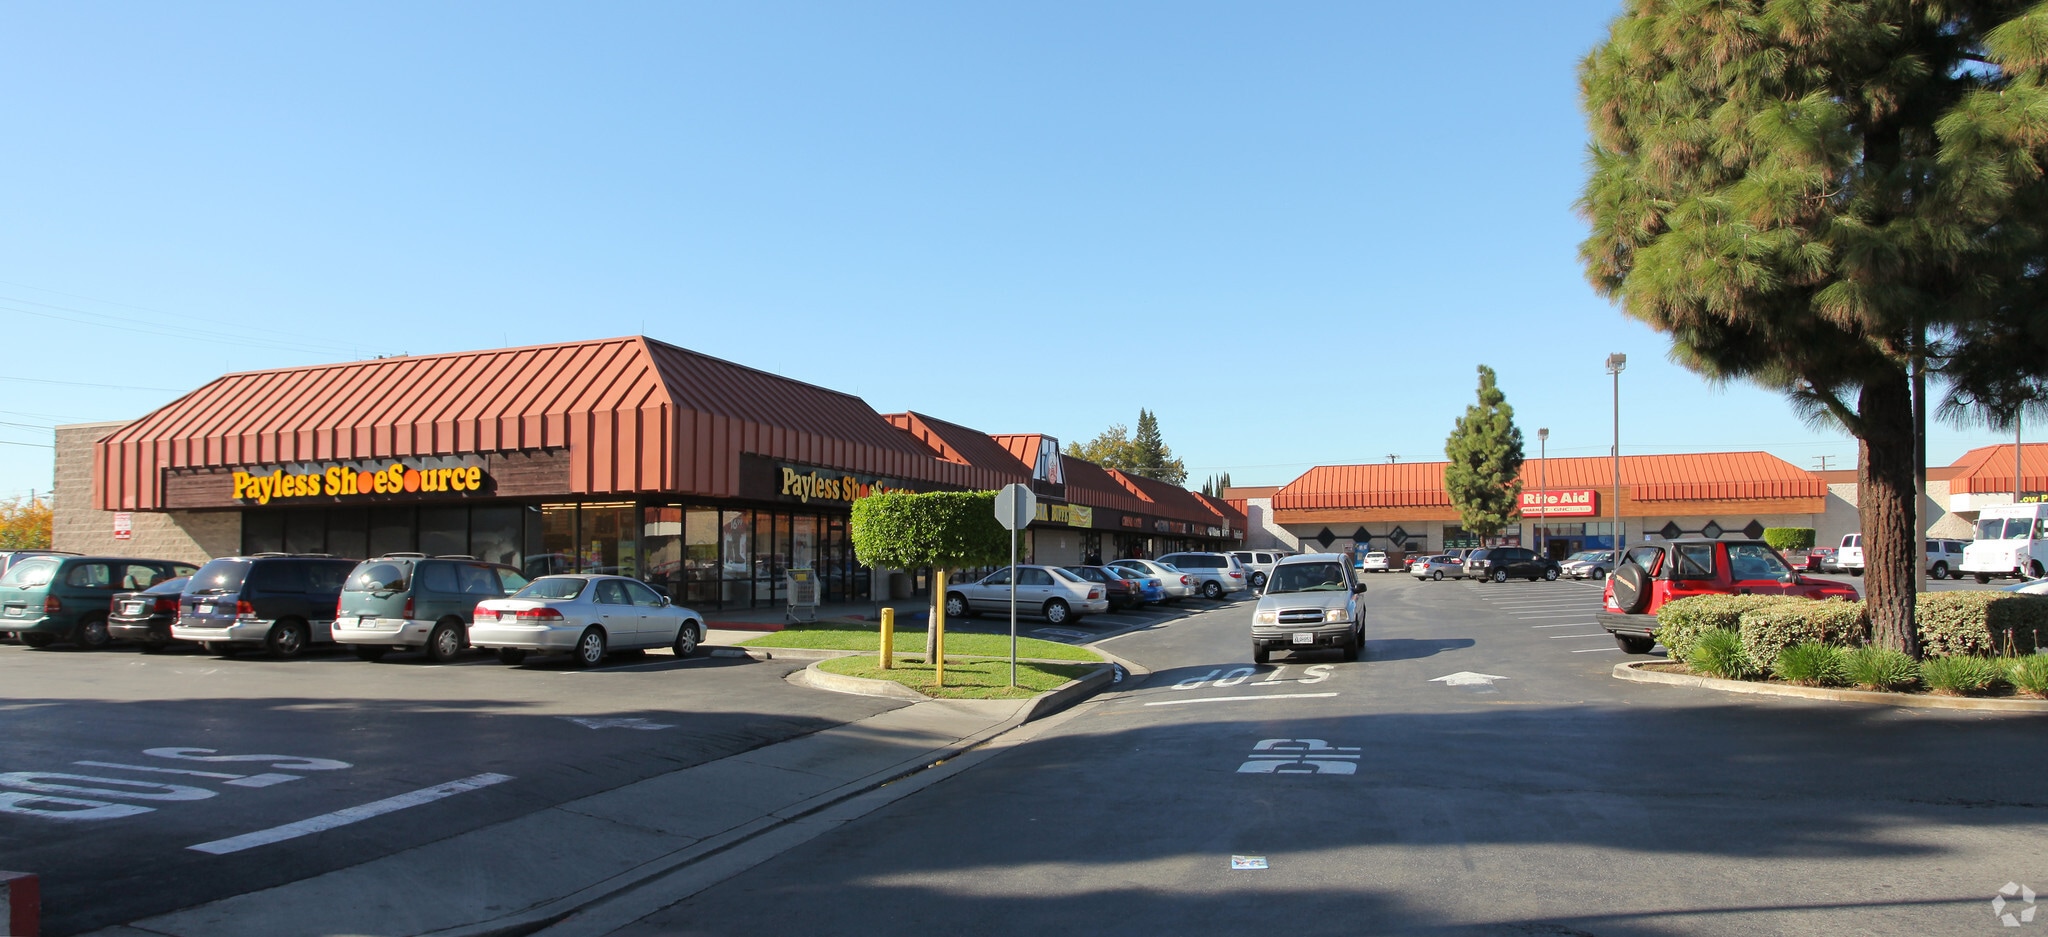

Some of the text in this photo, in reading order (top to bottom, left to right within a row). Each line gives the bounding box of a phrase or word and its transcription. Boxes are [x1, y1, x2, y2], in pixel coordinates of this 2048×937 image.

[232, 464, 481, 505] Payless ShoeSource
[782, 467, 915, 503] Payless ShoeS
[1523, 491, 1589, 505] Rite Aid
[2019, 494, 2039, 503] ow
[1171, 663, 1335, 691] STOP
